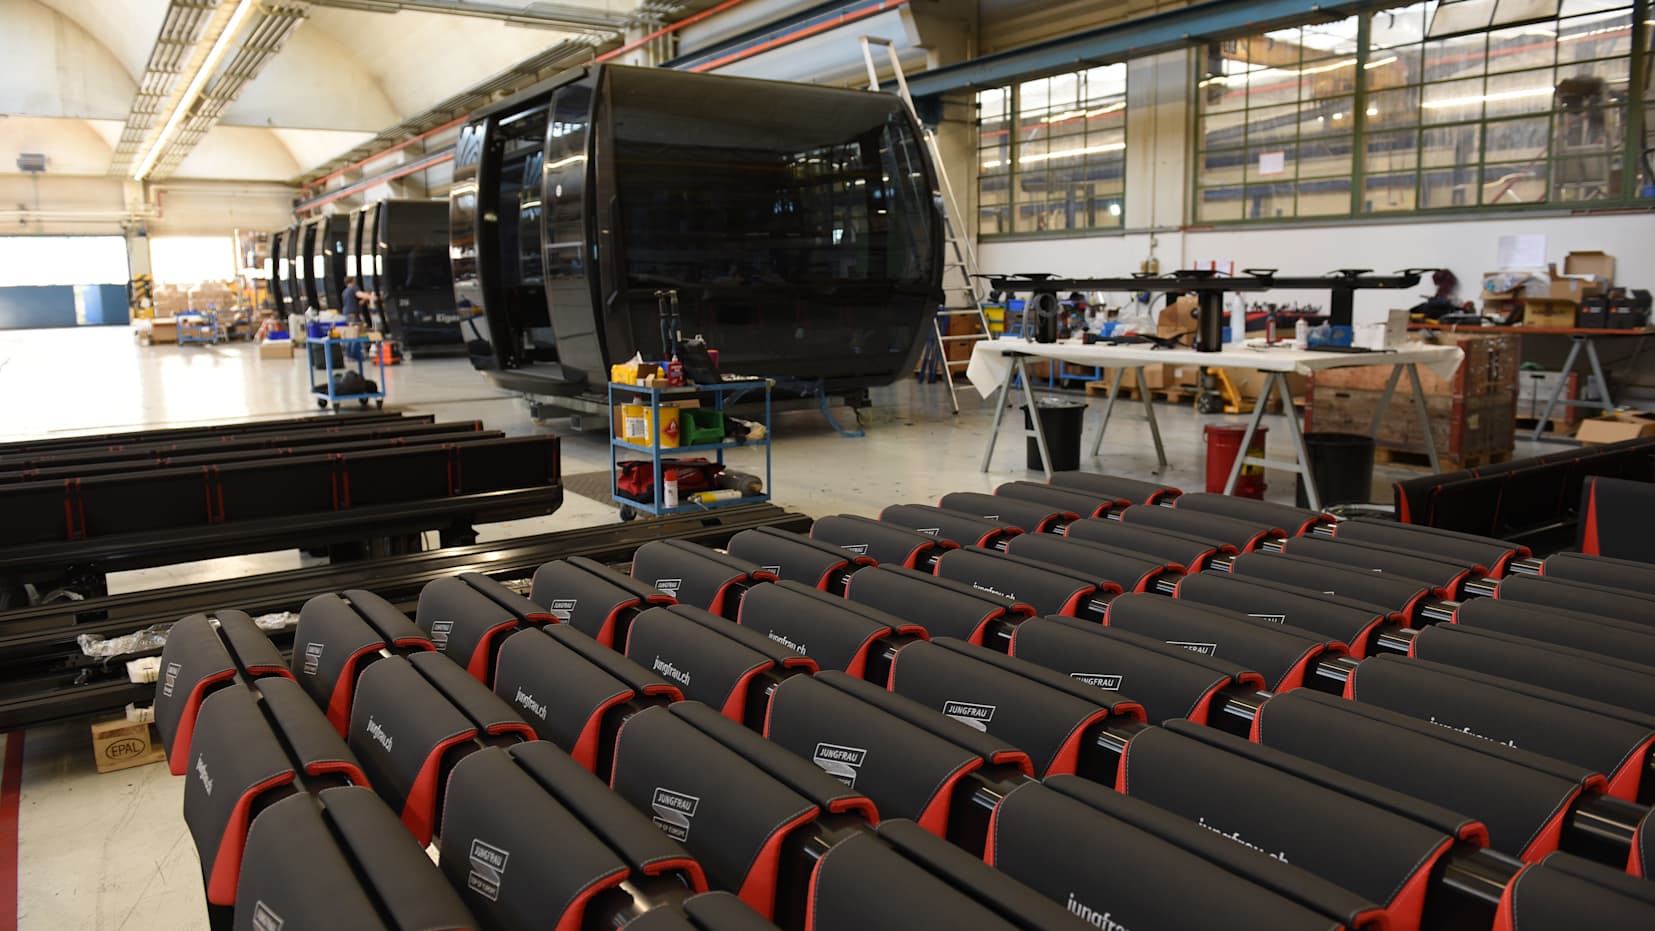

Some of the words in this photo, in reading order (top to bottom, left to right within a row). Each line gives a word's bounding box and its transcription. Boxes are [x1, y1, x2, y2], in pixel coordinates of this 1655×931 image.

[653, 655, 691, 686] jungfrau.ch
[948, 705, 987, 718] JUNGFRAU
[111, 742, 139, 757] EPAL
[820, 748, 859, 762] JUNGFRAU
[658, 793, 692, 811] JUNGFRAU
